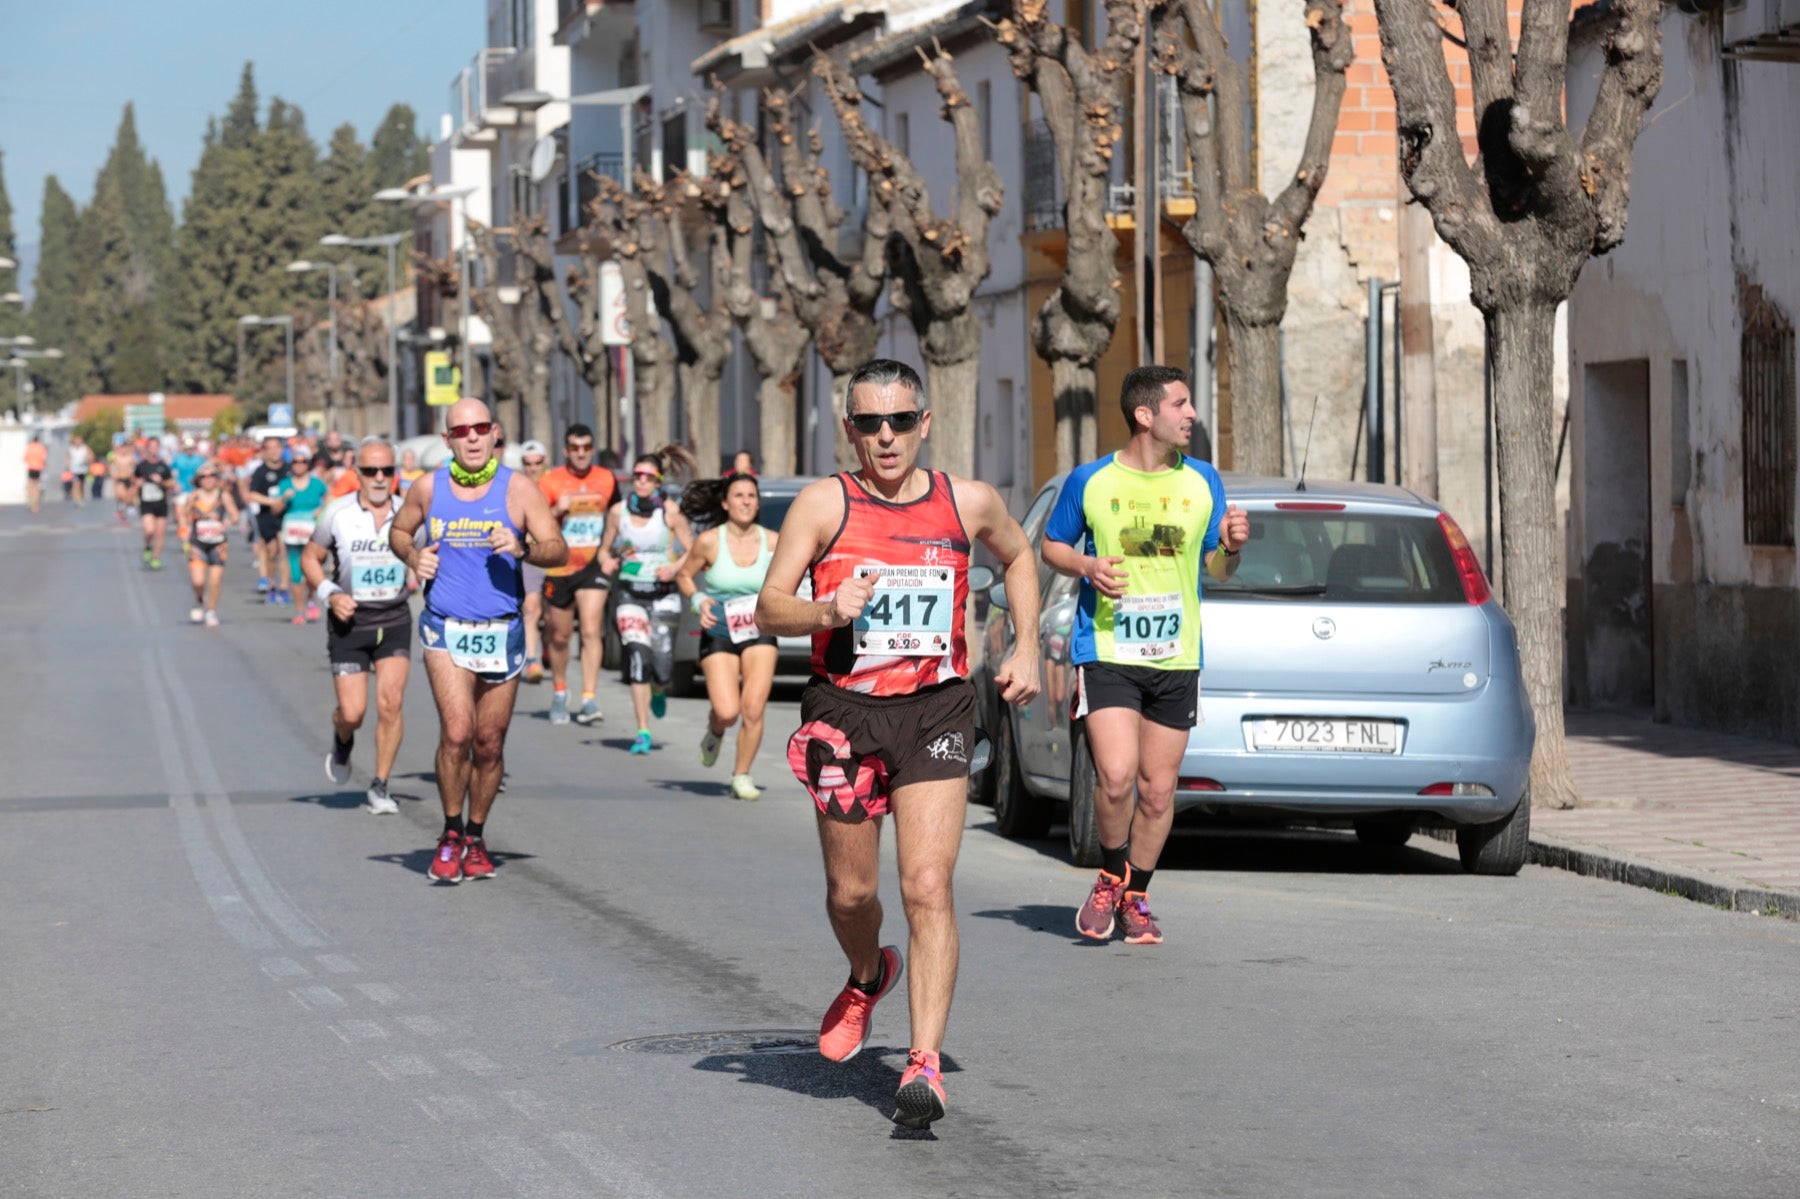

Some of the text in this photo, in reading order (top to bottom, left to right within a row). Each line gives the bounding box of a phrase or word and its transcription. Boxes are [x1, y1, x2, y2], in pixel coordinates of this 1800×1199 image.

[361, 567, 397, 585] 464
[880, 568, 895, 577] GRAN
[896, 568, 919, 577] PREMIO
[920, 568, 927, 577] DE
[870, 594, 938, 626] 417
[1119, 613, 1180, 639] 1073
[456, 634, 496, 654] 453
[1275, 720, 1389, 745] 7023 FNL
